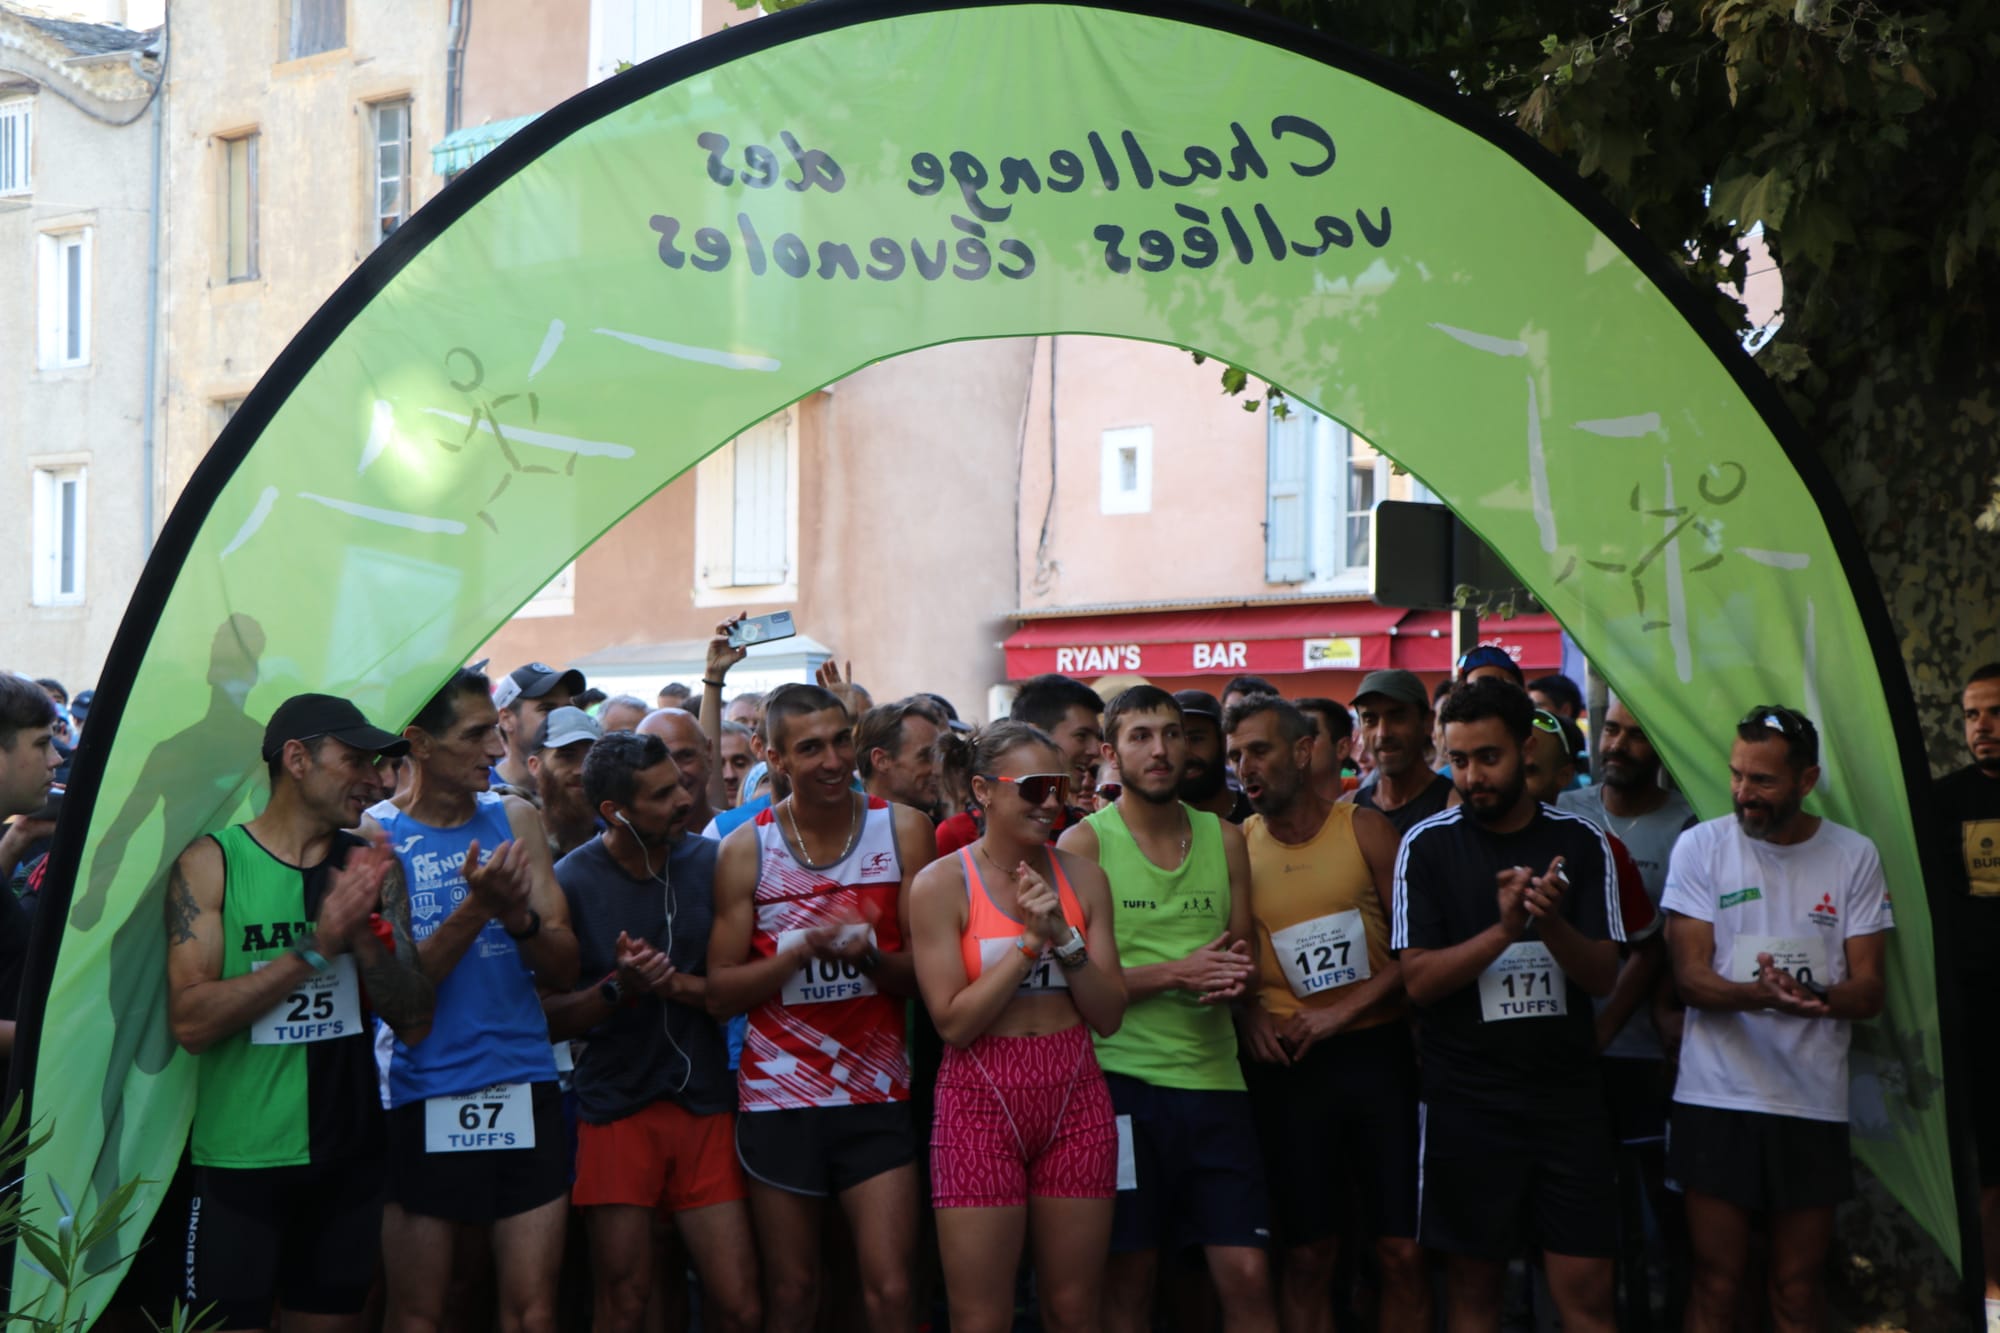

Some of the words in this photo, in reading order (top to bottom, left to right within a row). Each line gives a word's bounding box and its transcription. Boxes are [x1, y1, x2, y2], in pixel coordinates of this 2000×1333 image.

[1057, 645, 1141, 672] RYAN'S
[1193, 642, 1247, 669] BAR
[1122, 900, 1156, 909] TUFF'S
[1296, 940, 1351, 975] 127
[800, 982, 861, 1000] TUFF'S
[1302, 967, 1356, 991] TUFF'S
[1502, 971, 1551, 998] 171
[286, 991, 334, 1022] 25
[1499, 1000, 1558, 1015] TUFF'S
[274, 1020, 344, 1040] TUFF'S
[459, 1102, 503, 1130] 67
[448, 1132, 516, 1147] TUFF'S
